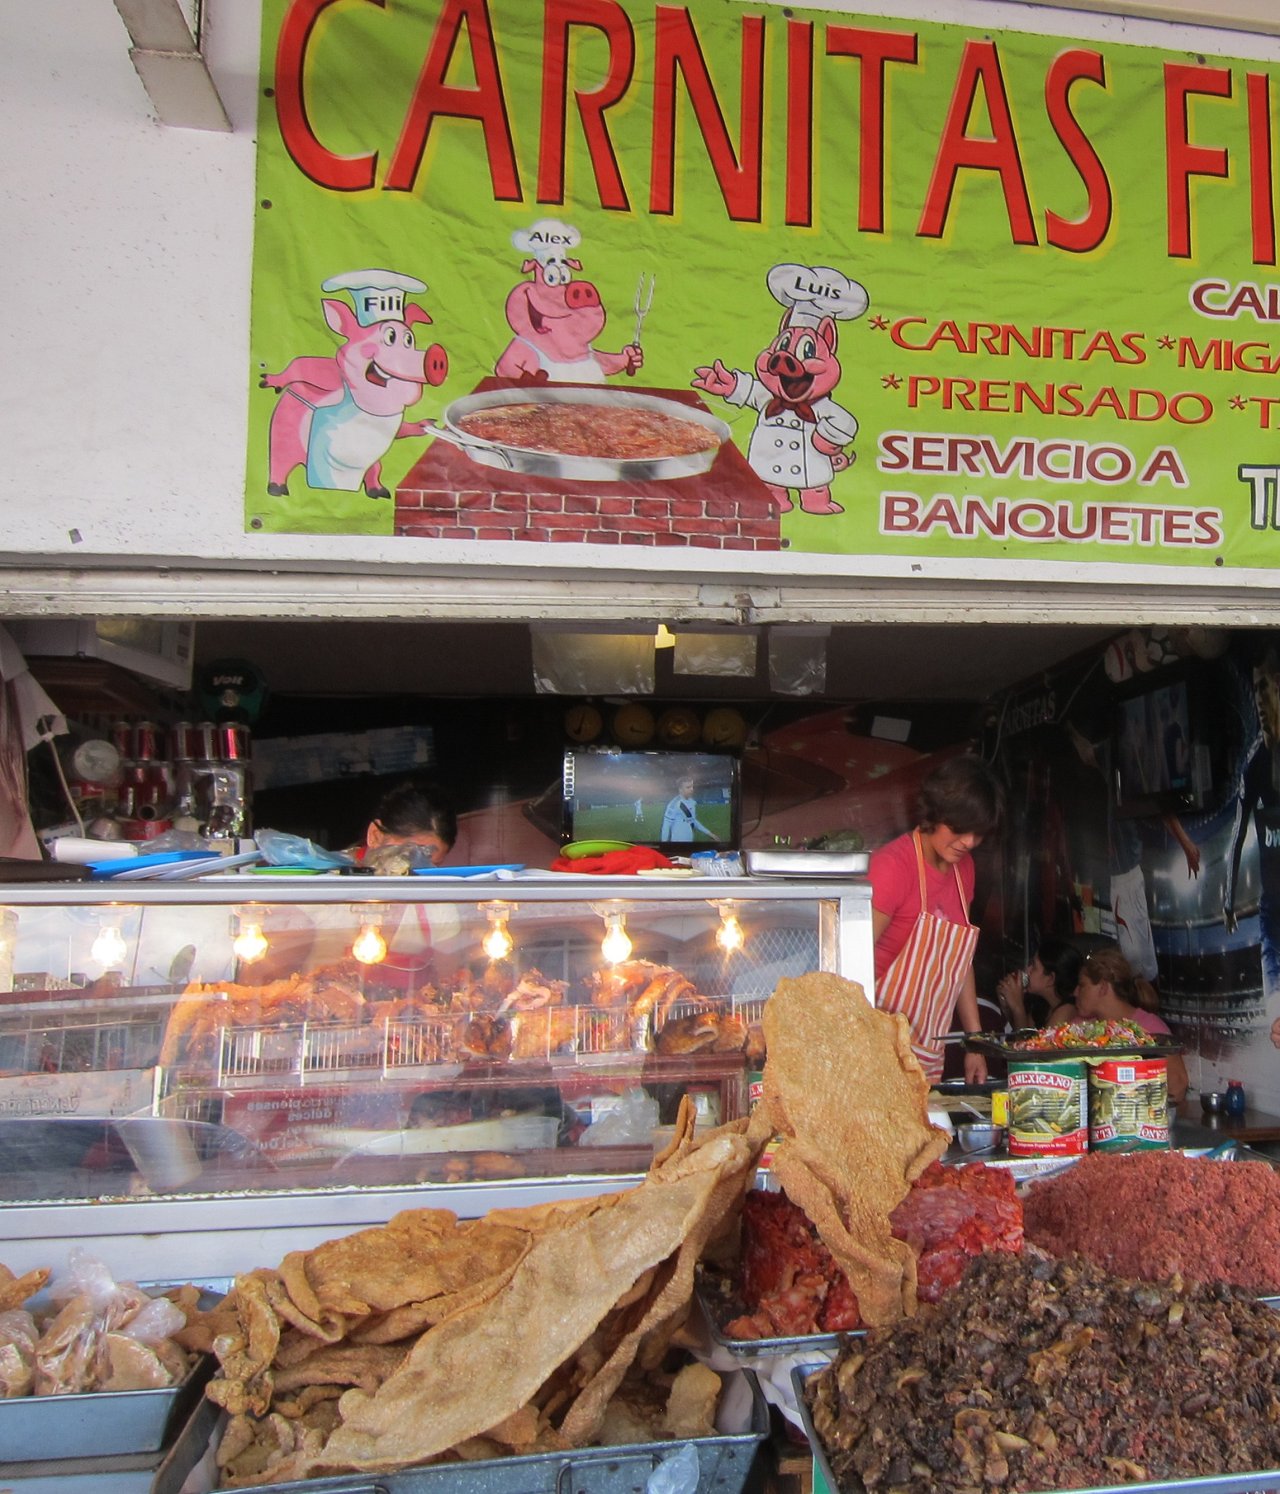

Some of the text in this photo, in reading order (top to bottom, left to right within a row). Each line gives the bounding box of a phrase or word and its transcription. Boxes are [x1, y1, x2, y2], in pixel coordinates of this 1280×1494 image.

[275, 0, 1113, 254] CARNITAS
[529, 231, 572, 246] Alex
[795, 276, 841, 301] Luis
[363, 296, 403, 313] Fili
[880, 434, 1187, 485] SERVICIO A
[882, 496, 1223, 546] BANQUETES
[1015, 1072, 1071, 1090] MEXICANO
